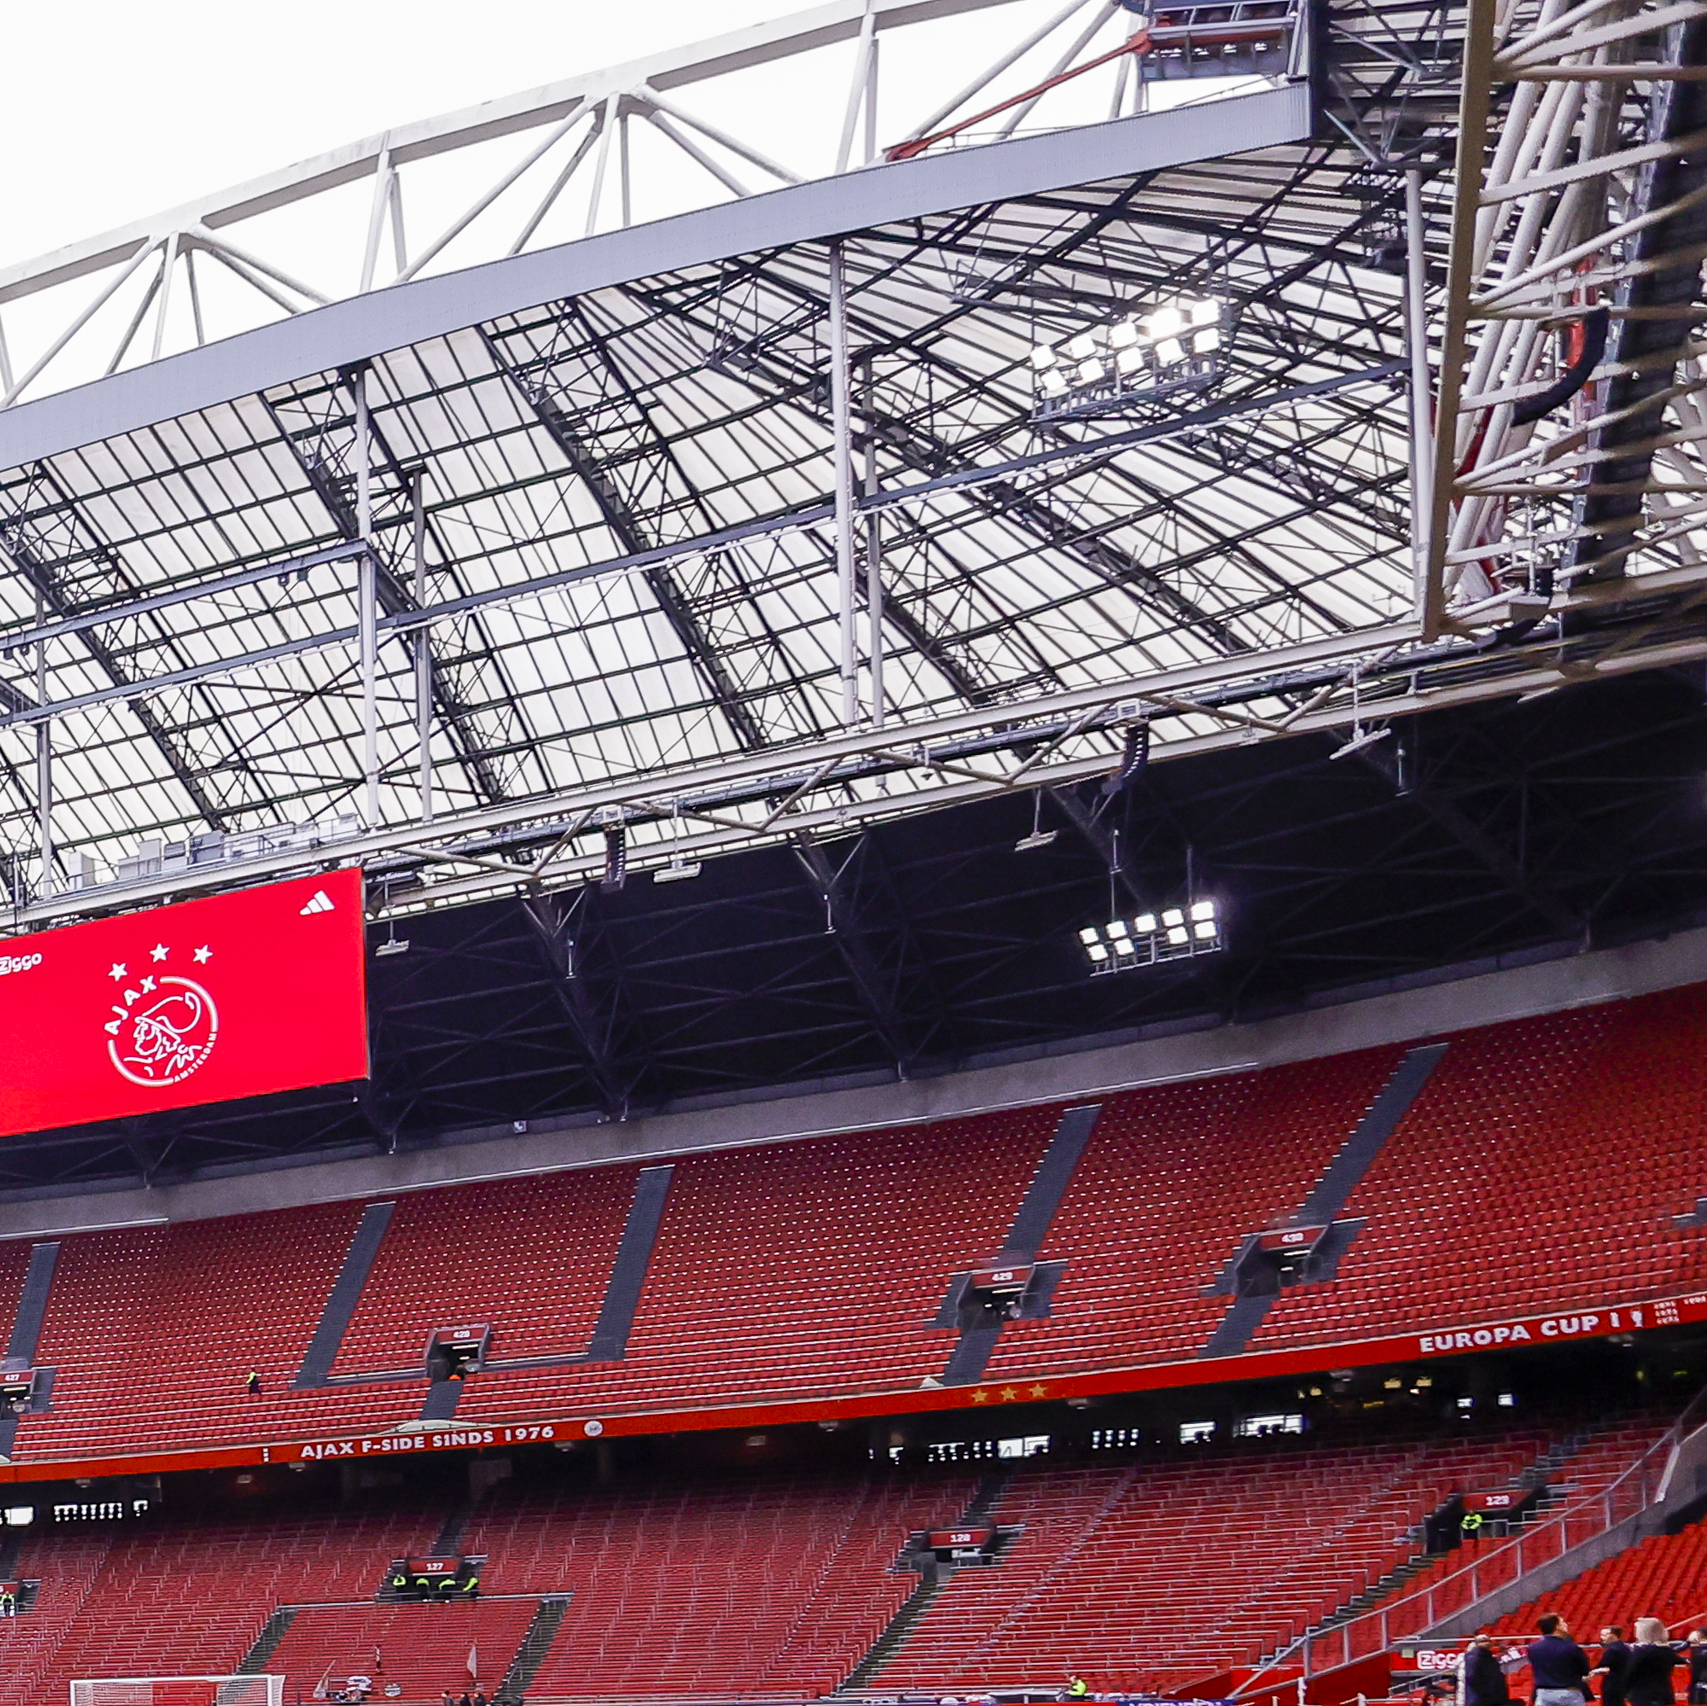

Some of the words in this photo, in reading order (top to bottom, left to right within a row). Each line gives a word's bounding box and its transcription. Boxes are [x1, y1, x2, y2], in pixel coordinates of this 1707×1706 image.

[104, 975, 157, 1036] AJAX
[173, 1032, 217, 1083] AMSTERDAM
[1419, 1325, 1531, 1353] EUROPA
[1540, 1315, 1599, 1336] CUP
[300, 1441, 354, 1460] AJAX
[361, 1436, 425, 1453] F-SIDE
[432, 1430, 494, 1447] SINDS
[504, 1426, 554, 1442] 1976
[426, 1562, 444, 1571] 127
[1417, 1650, 1456, 1669] Zigg
